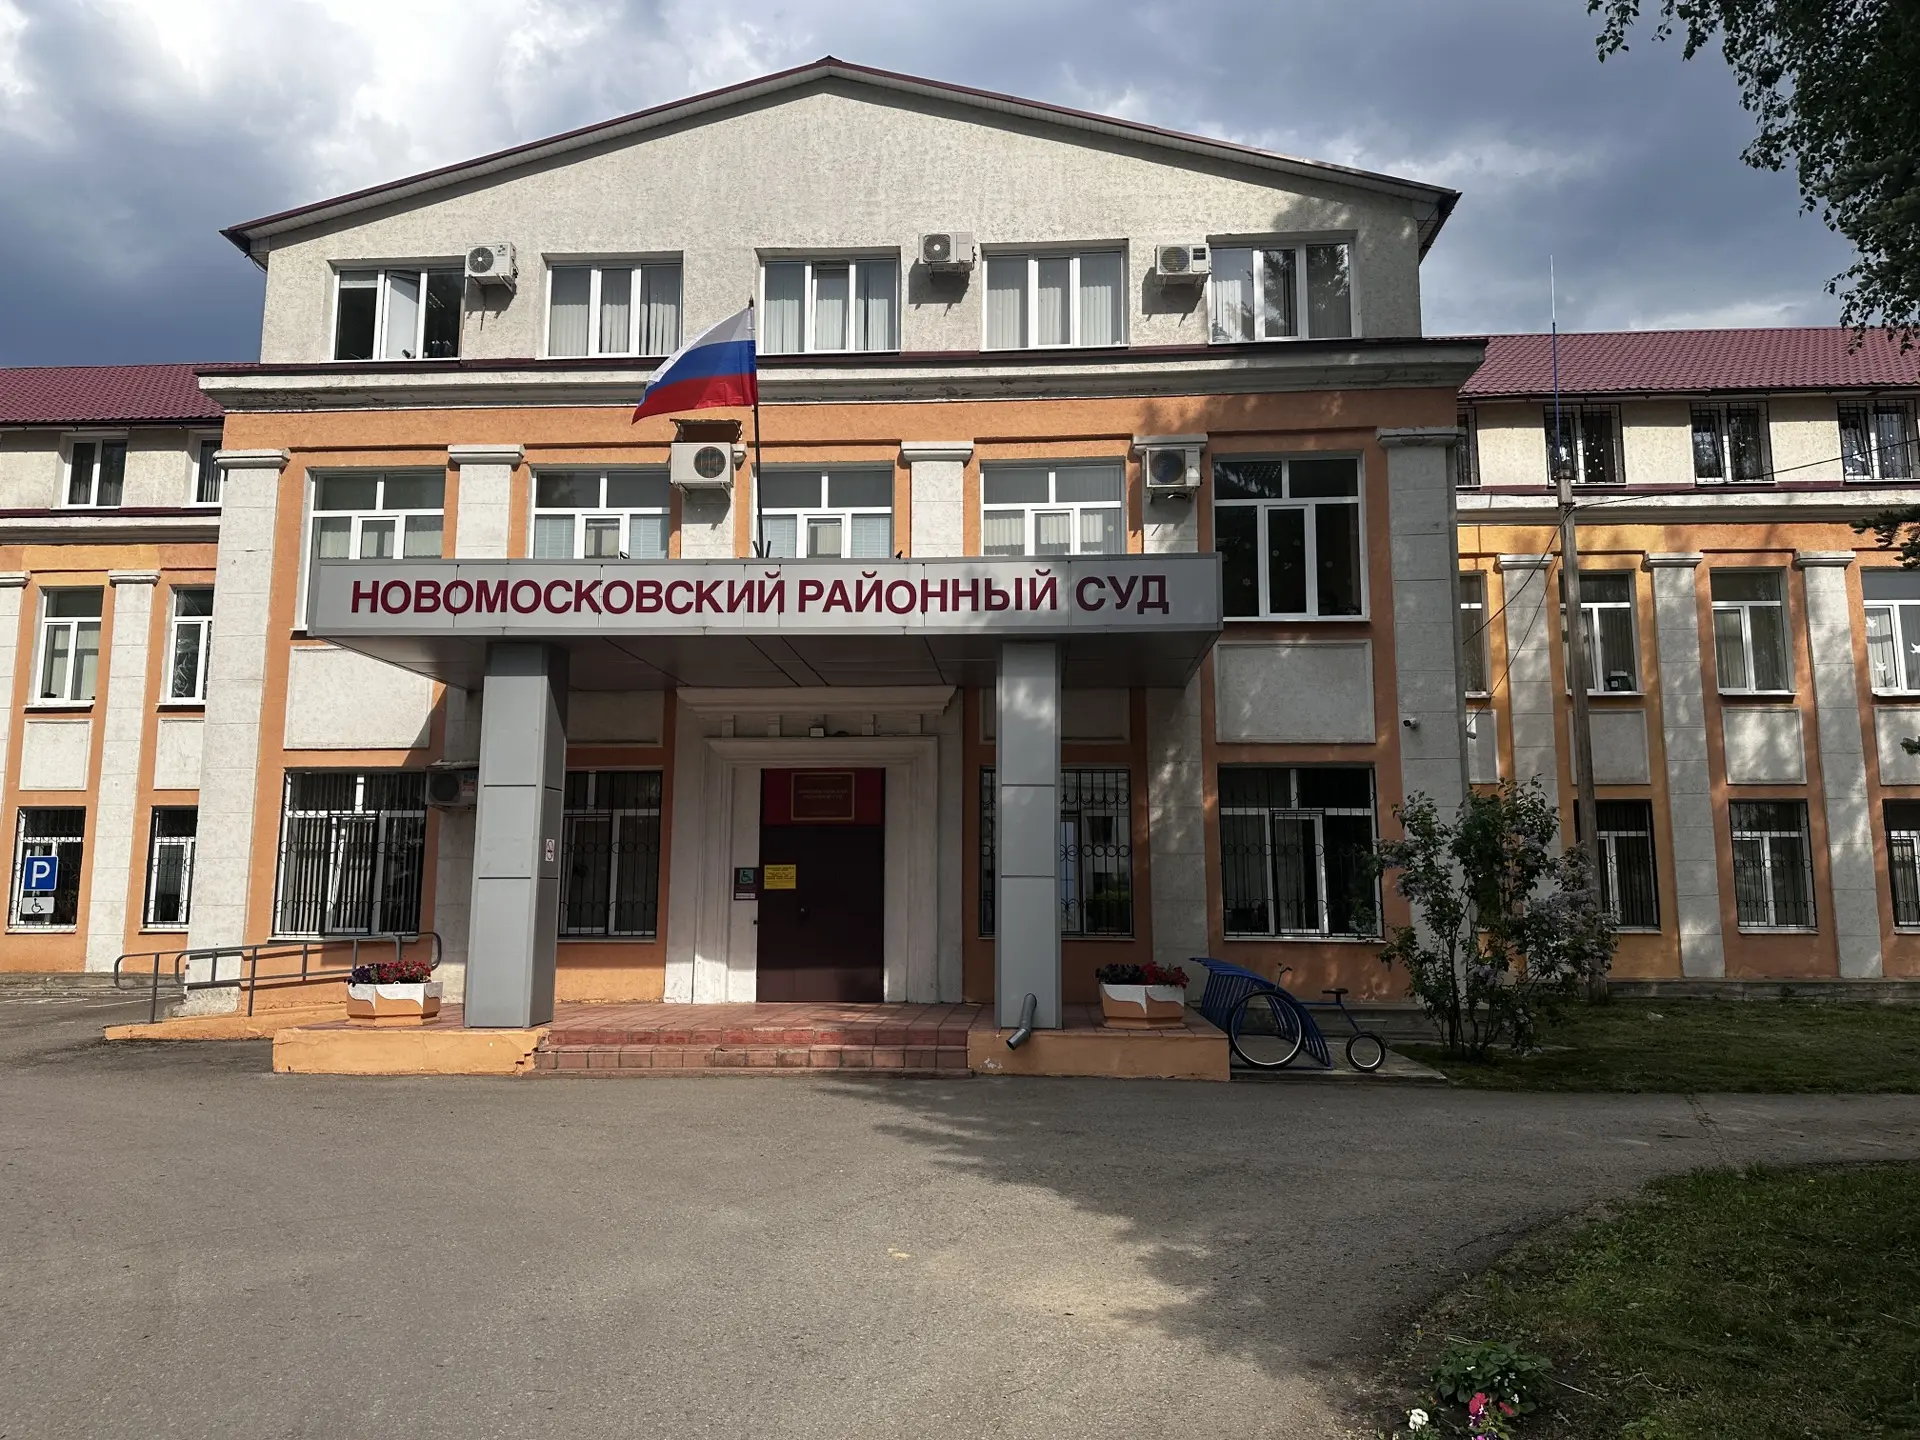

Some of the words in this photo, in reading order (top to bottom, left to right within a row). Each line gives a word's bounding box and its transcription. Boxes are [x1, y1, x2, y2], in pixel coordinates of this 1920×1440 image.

[351, 571, 785, 614] НОВОМОСКОВСКИЙ
[798, 569, 1057, 614] РАЙОННЫЙ
[1075, 575, 1170, 615] СУД
[32, 861, 50, 887] P
